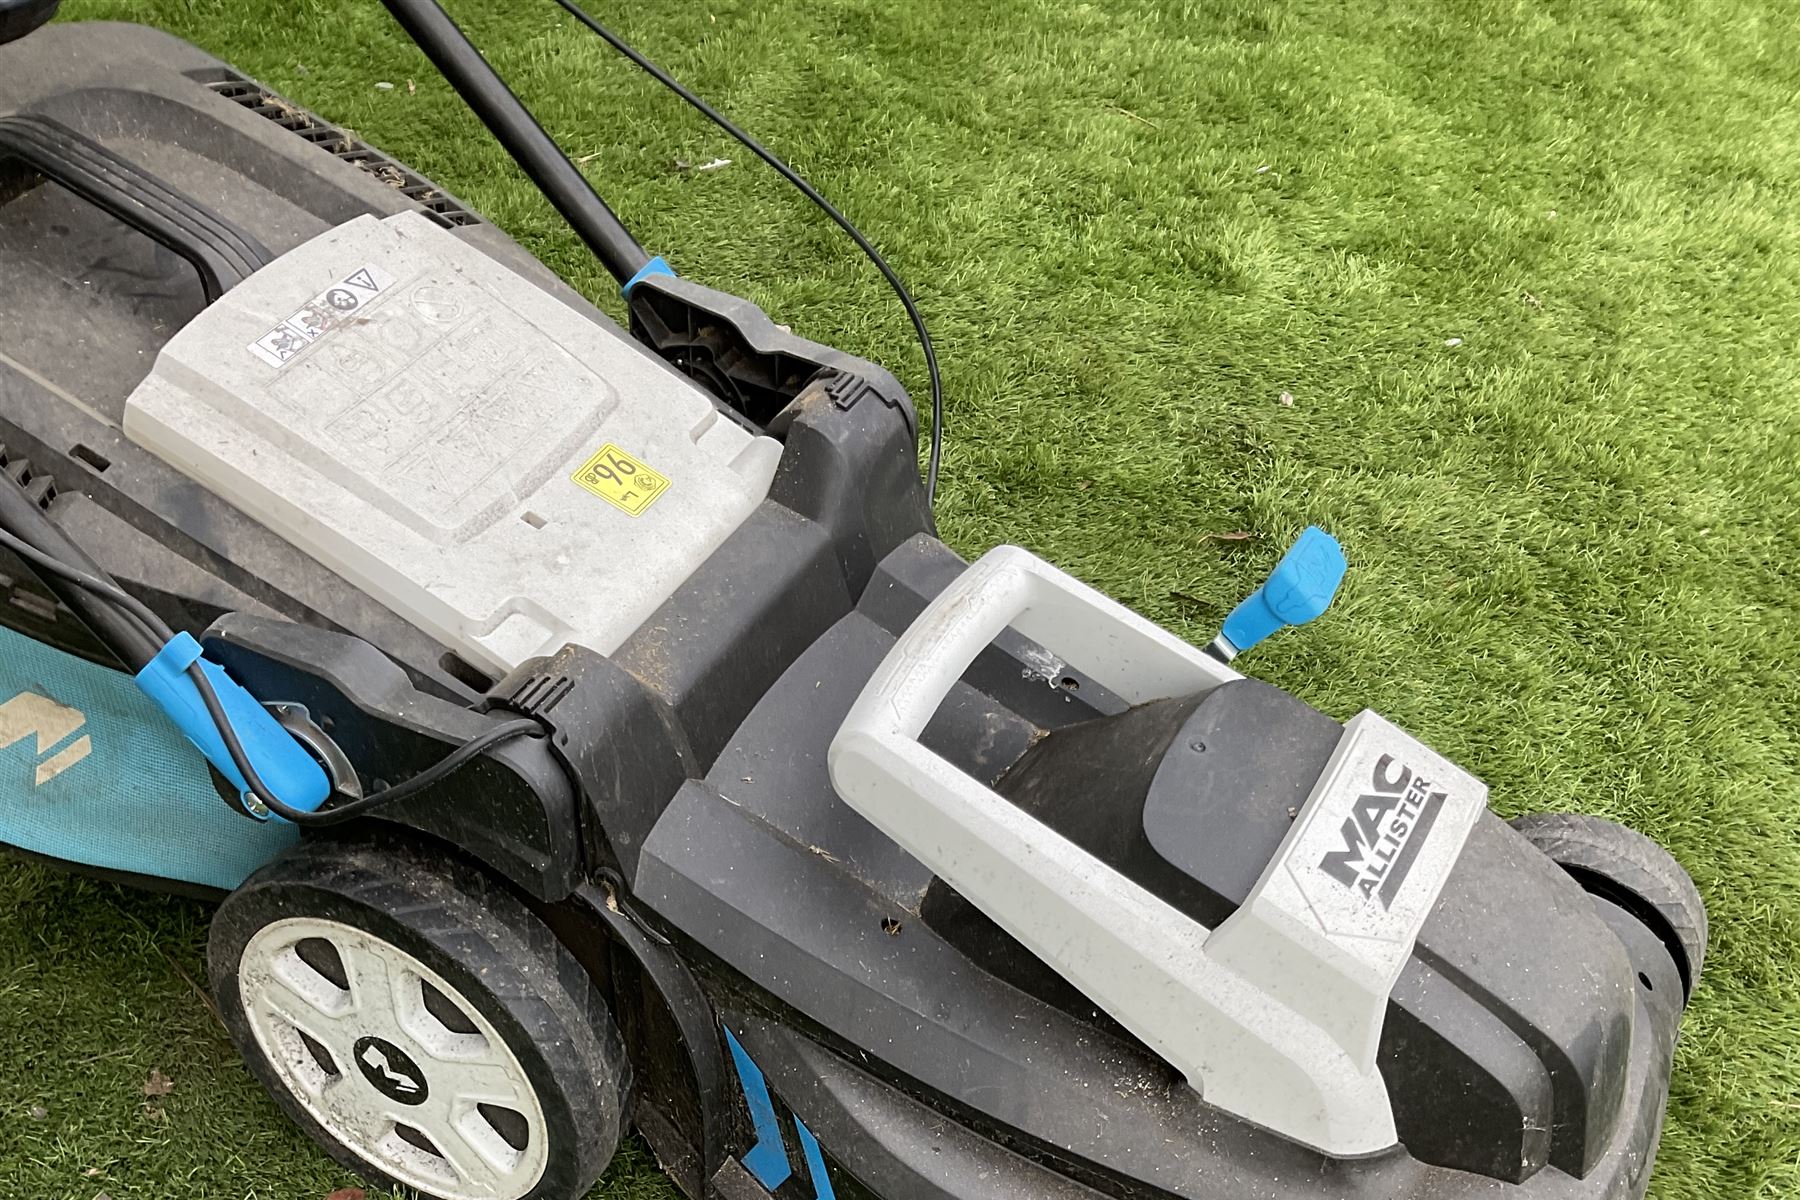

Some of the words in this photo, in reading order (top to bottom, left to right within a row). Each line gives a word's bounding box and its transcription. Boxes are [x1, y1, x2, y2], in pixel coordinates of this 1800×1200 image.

[593, 453, 636, 486] 96
[1318, 753, 1412, 888] MAC
[1357, 776, 1431, 900] ALLISTER
